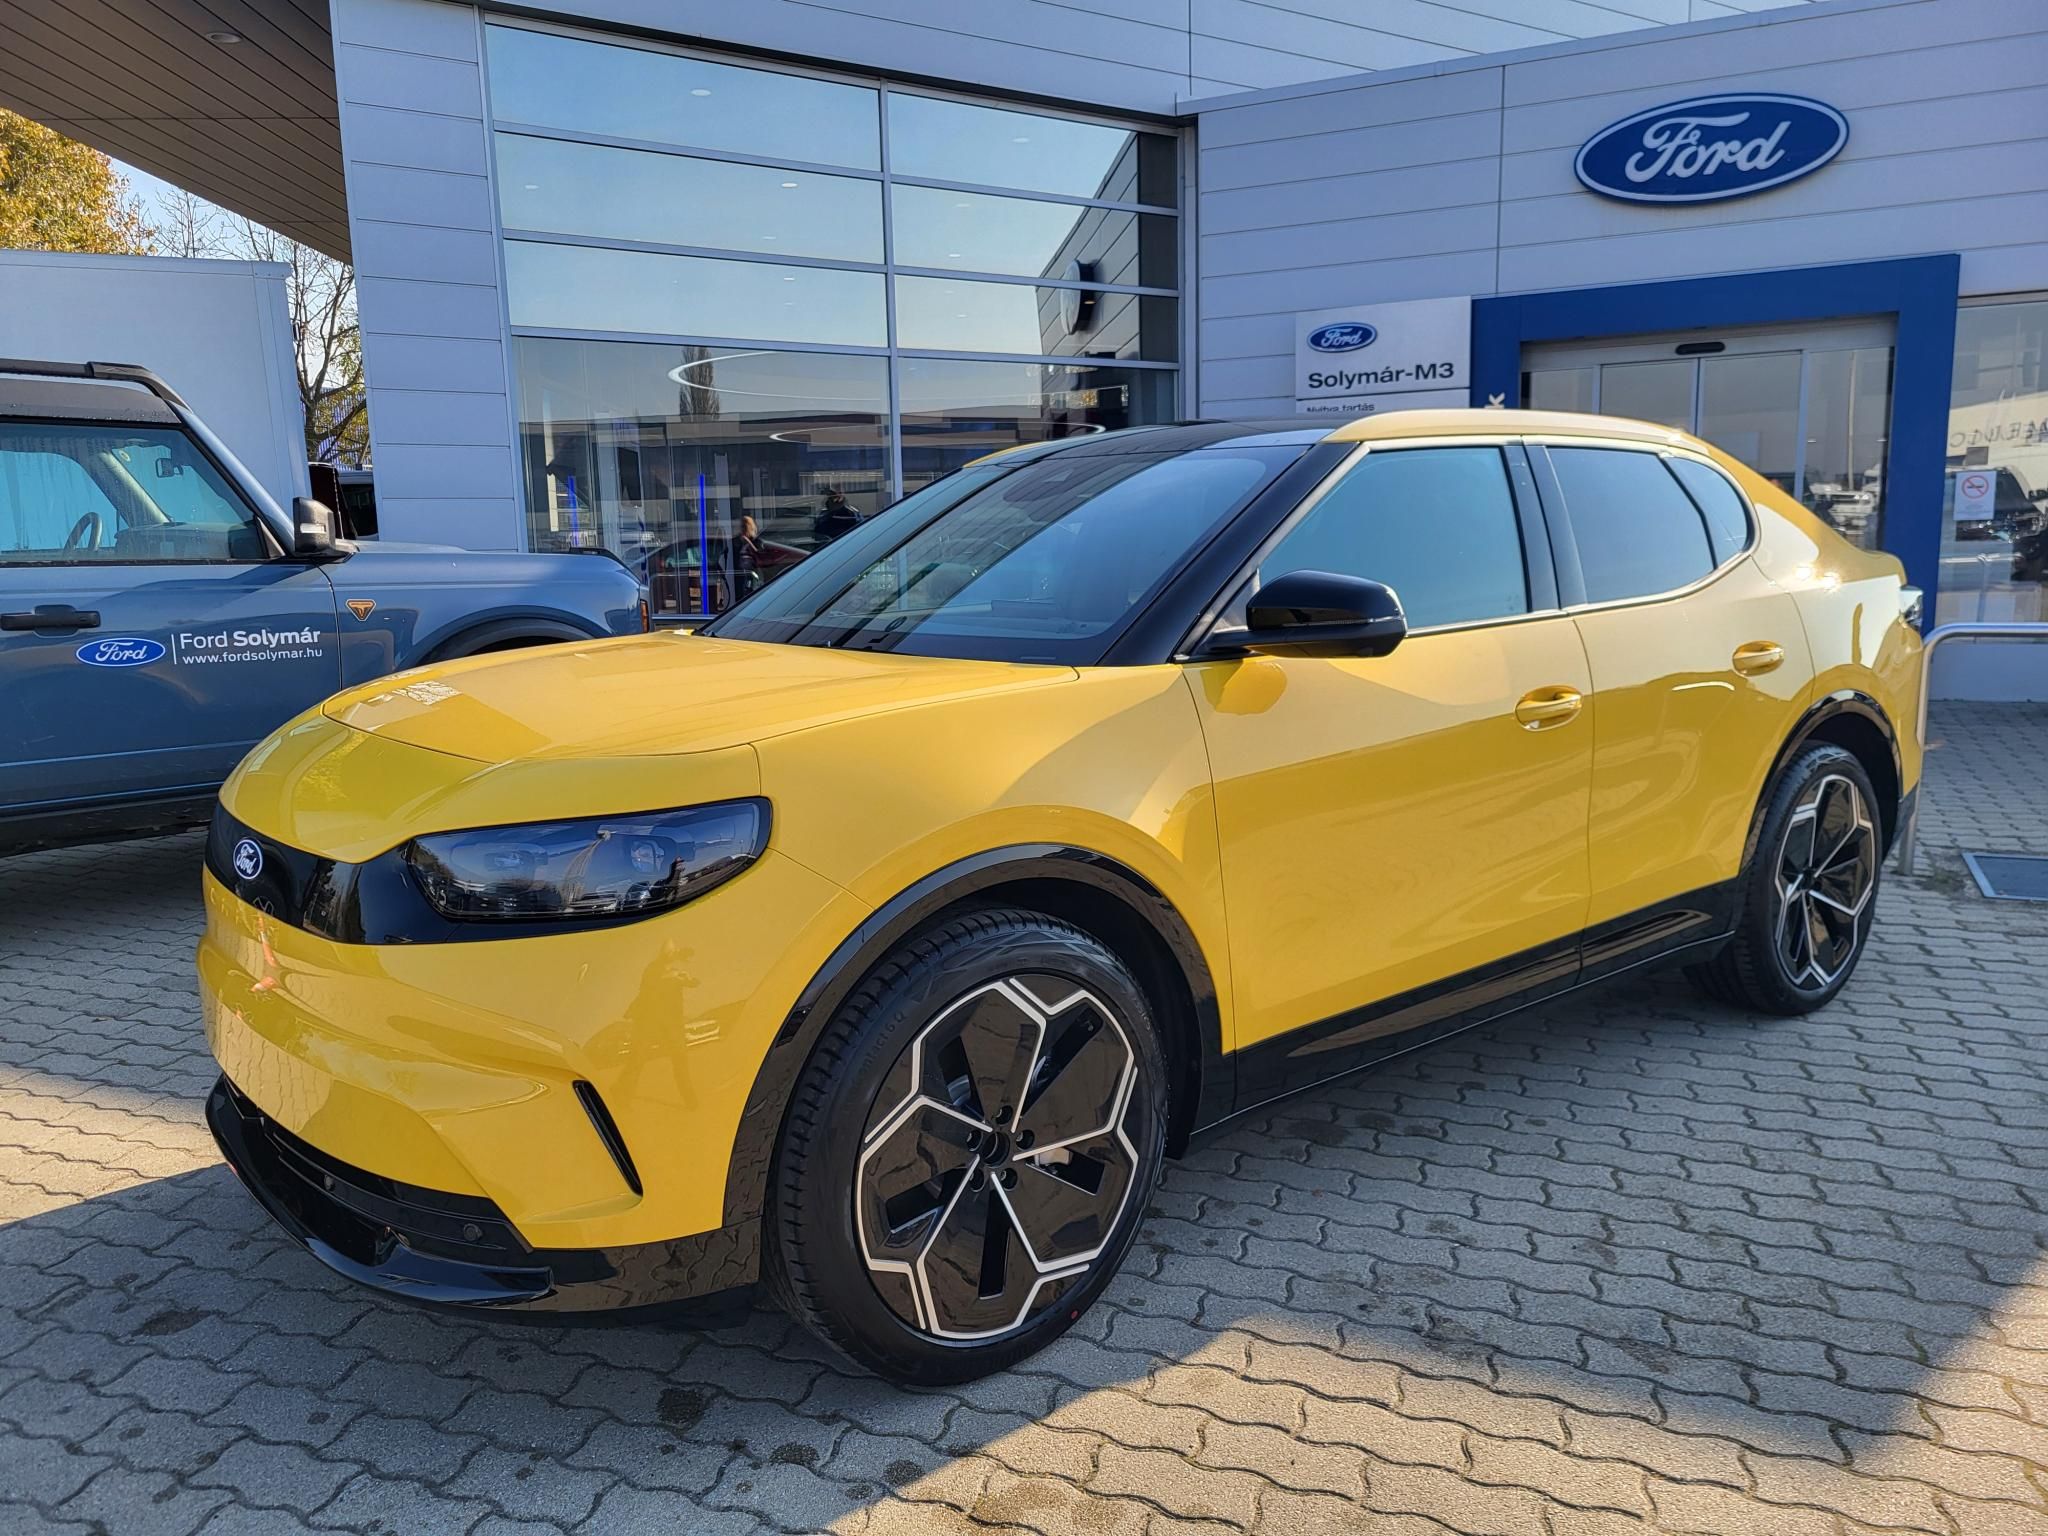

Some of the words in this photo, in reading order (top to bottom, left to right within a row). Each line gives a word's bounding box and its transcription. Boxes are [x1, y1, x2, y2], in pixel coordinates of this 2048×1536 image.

[1624, 111, 1792, 183] Ford
[1320, 328, 1362, 348] Ford
[1308, 362, 1454, 389] Solymár-M3
[180, 630, 228, 649] Ford
[233, 626, 321, 648] Solymár
[95, 641, 148, 662] Ford
[182, 647, 323, 665] www.fordsolymar.hu
[236, 843, 257, 874] Ford
